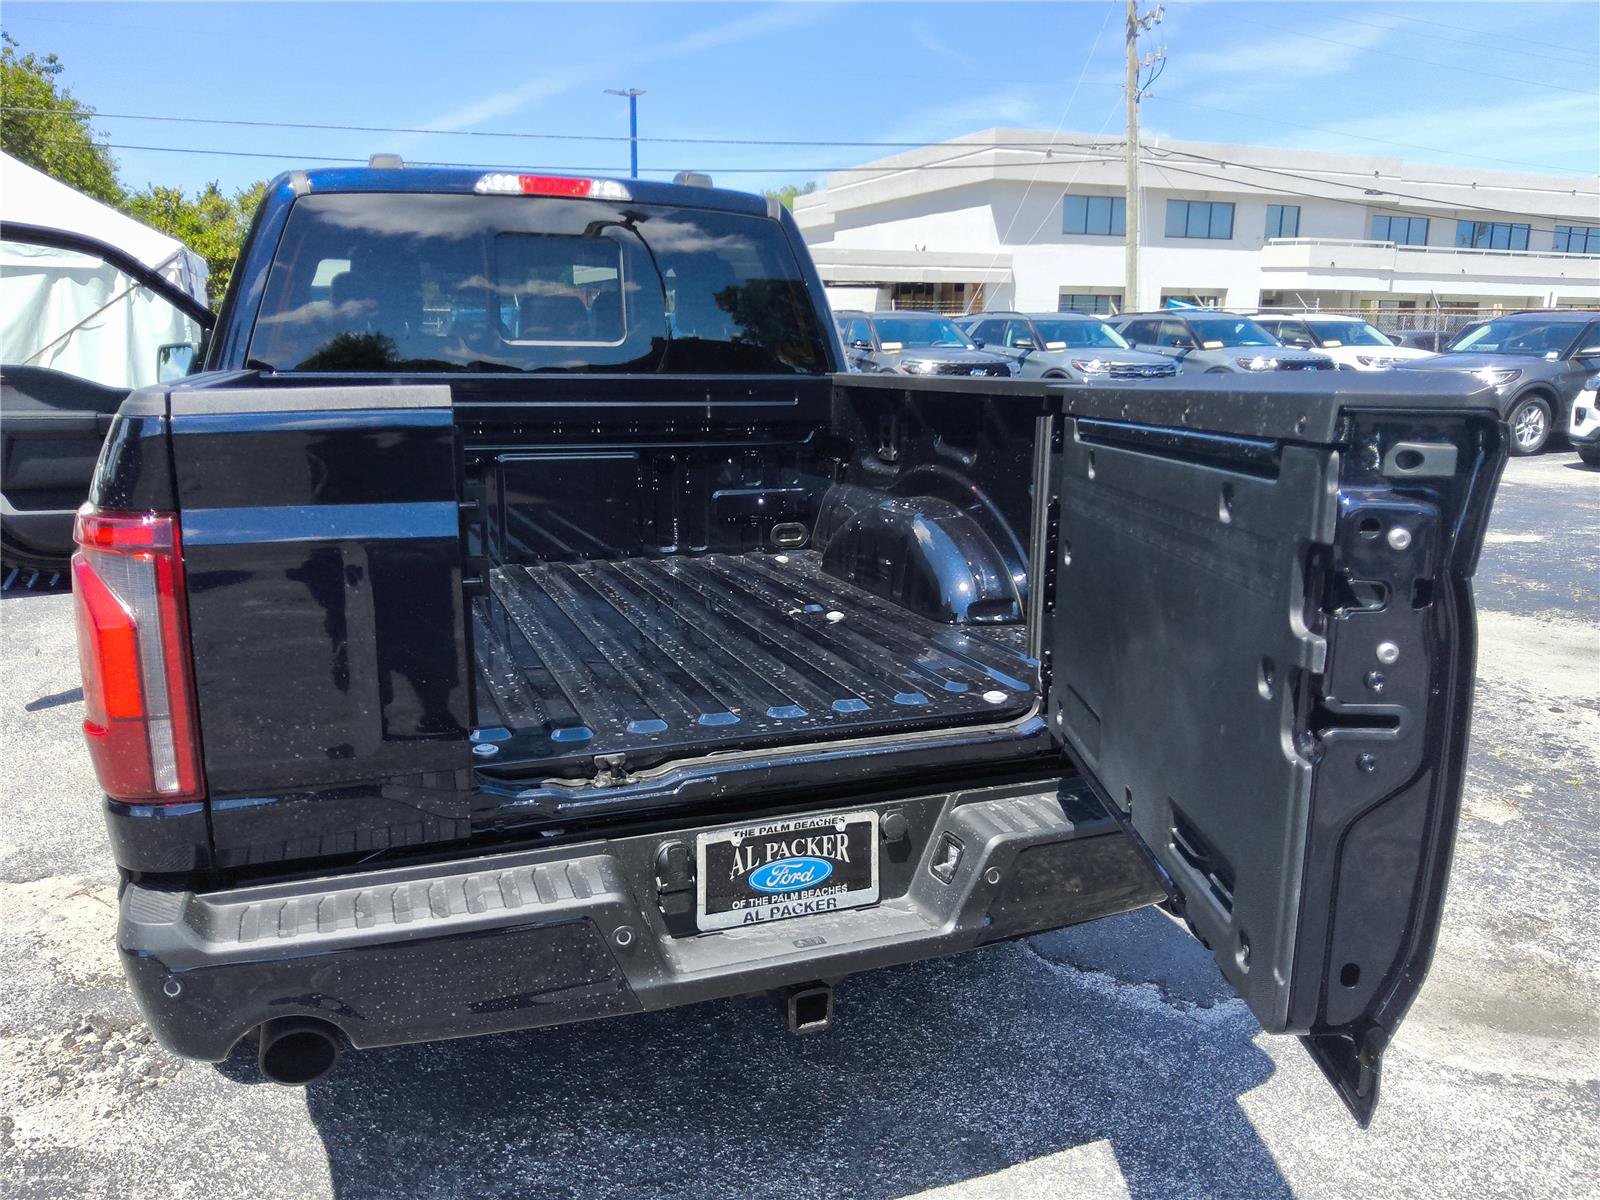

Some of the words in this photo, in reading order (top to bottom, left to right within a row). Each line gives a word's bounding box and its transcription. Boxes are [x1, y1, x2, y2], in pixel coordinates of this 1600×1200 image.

[734, 830, 755, 838] THE
[759, 823, 790, 834] PALM
[794, 816, 846, 830] BEACHES
[729, 846, 760, 880] AL
[765, 833, 850, 863] PACKER
[766, 863, 815, 887] Ford
[732, 900, 747, 910] OF
[749, 896, 768, 907] THE
[772, 891, 799, 903] PALM
[801, 884, 848, 900] BEACHES
[743, 910, 764, 924] AL
[770, 897, 837, 919] PACKER
